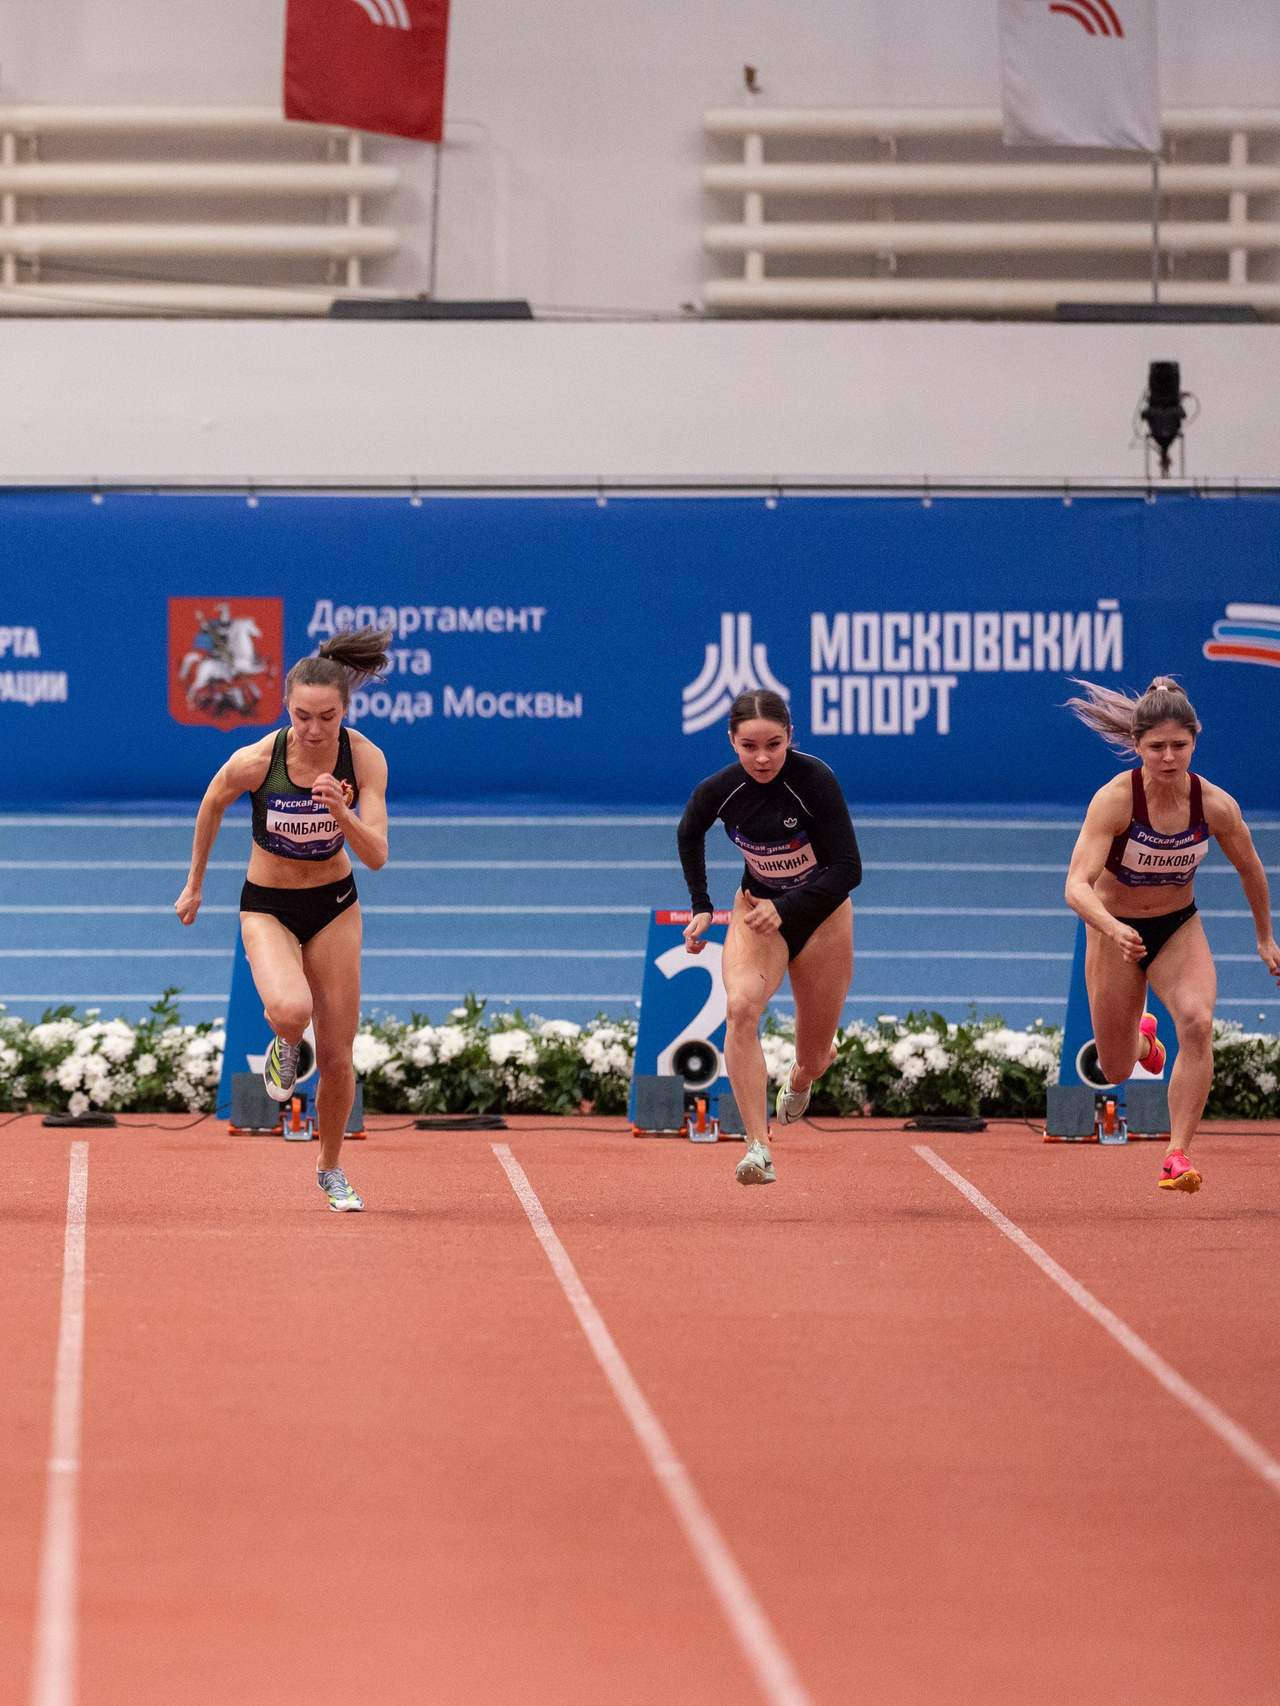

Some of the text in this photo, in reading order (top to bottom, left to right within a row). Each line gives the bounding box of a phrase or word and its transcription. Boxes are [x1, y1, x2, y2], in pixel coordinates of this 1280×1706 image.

[307, 599, 547, 639] Департамент
[811, 599, 1123, 672] МОСКОВСКИЙ
[347, 685, 583, 726] рода Москвы
[811, 675, 958, 735] СПОРТ
[275, 799, 313, 810] Русская
[1137, 831, 1176, 845] Русская
[1138, 852, 1196, 867] ТАТЬКОВА
[654, 940, 728, 1076] 2
